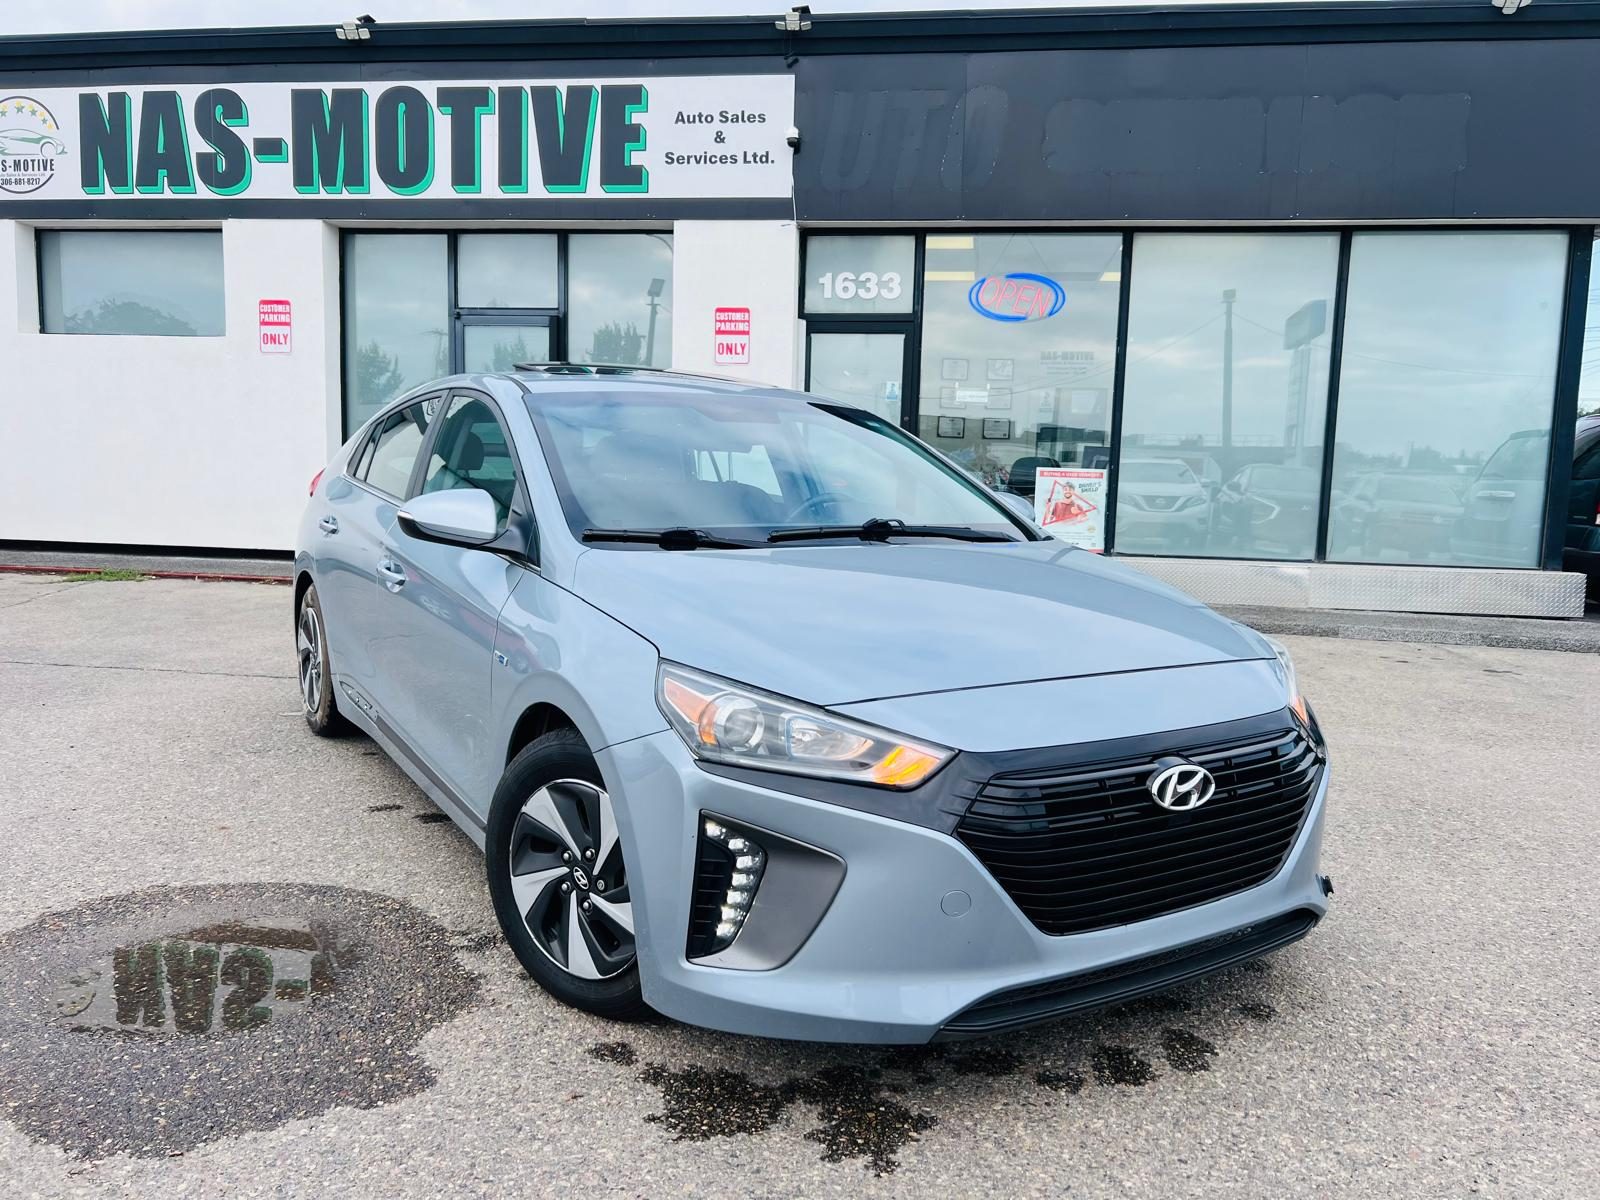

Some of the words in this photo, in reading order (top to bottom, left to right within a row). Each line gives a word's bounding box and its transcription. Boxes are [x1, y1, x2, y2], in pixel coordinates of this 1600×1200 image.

[674, 111, 714, 125] Auto
[718, 110, 767, 124] Sales
[79, 84, 649, 196] NAS-MOTIVE
[714, 130, 726, 144] &
[664, 151, 738, 165] Services
[743, 150, 775, 165] Ltd.
[0, 158, 55, 172] S-MOTIVE
[818, 271, 902, 300] 1633
[980, 276, 1053, 317] OPEN
[260, 304, 290, 312] CUSTOMER
[260, 313, 290, 322] PARKING
[716, 312, 749, 321] CUSTOMER
[716, 322, 749, 331] PARKING
[262, 333, 288, 345] ONLY
[717, 342, 746, 355] ONLY
